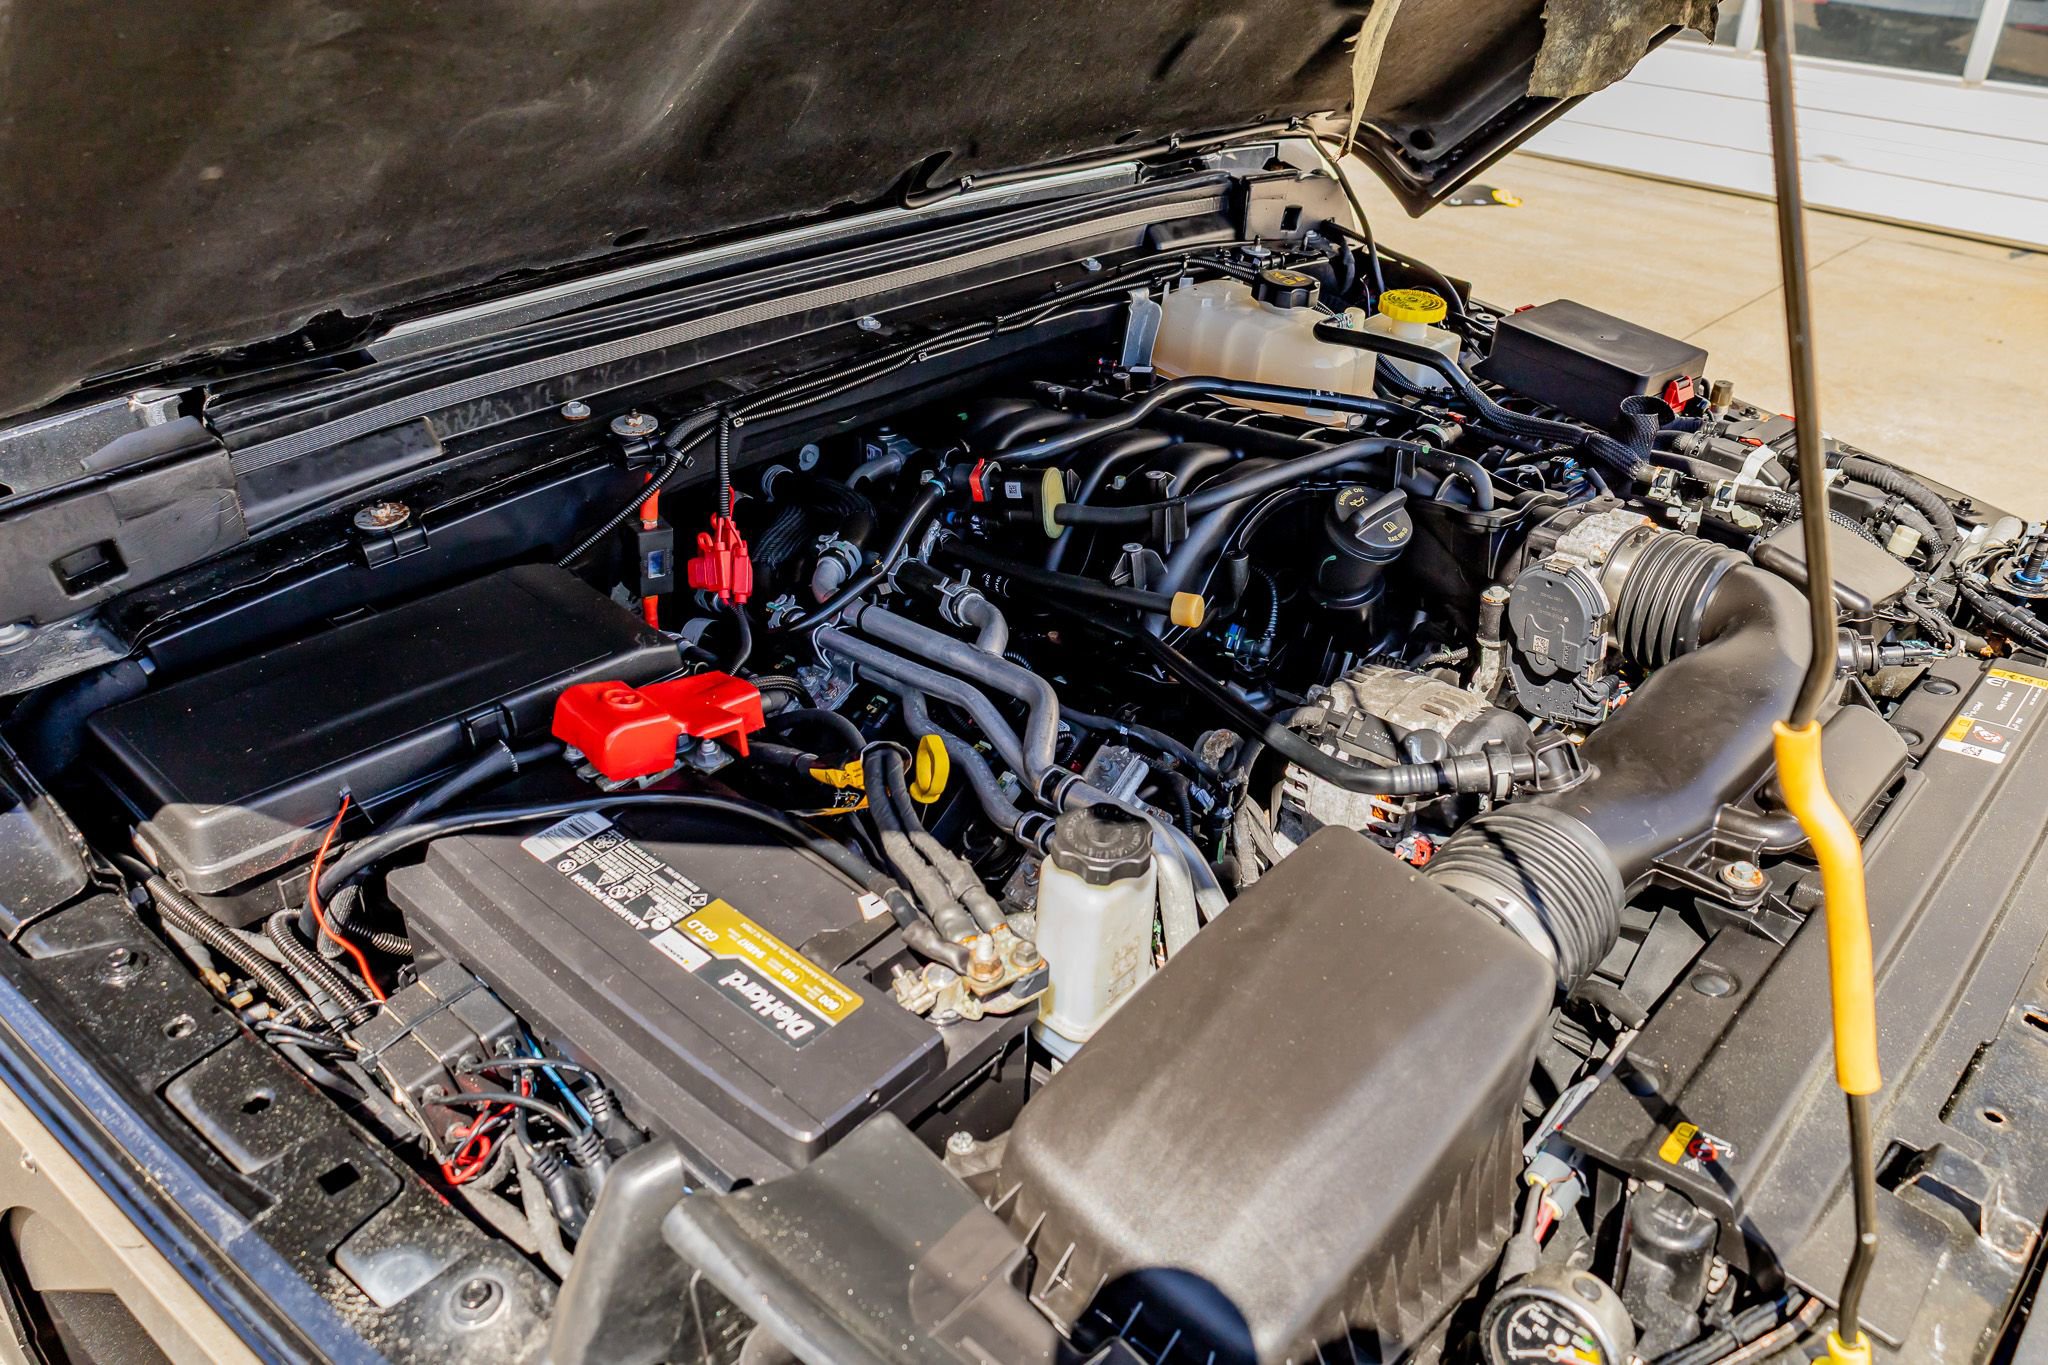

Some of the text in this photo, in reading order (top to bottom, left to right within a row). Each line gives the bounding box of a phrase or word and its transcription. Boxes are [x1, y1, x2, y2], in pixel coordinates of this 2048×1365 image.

[1339, 489, 1353, 506] ENGINE
[571, 873, 641, 925] DANGER/POISON
[688, 920, 718, 941] GOLD
[782, 969, 798, 982] 140
[718, 969, 815, 1039] DieHard
